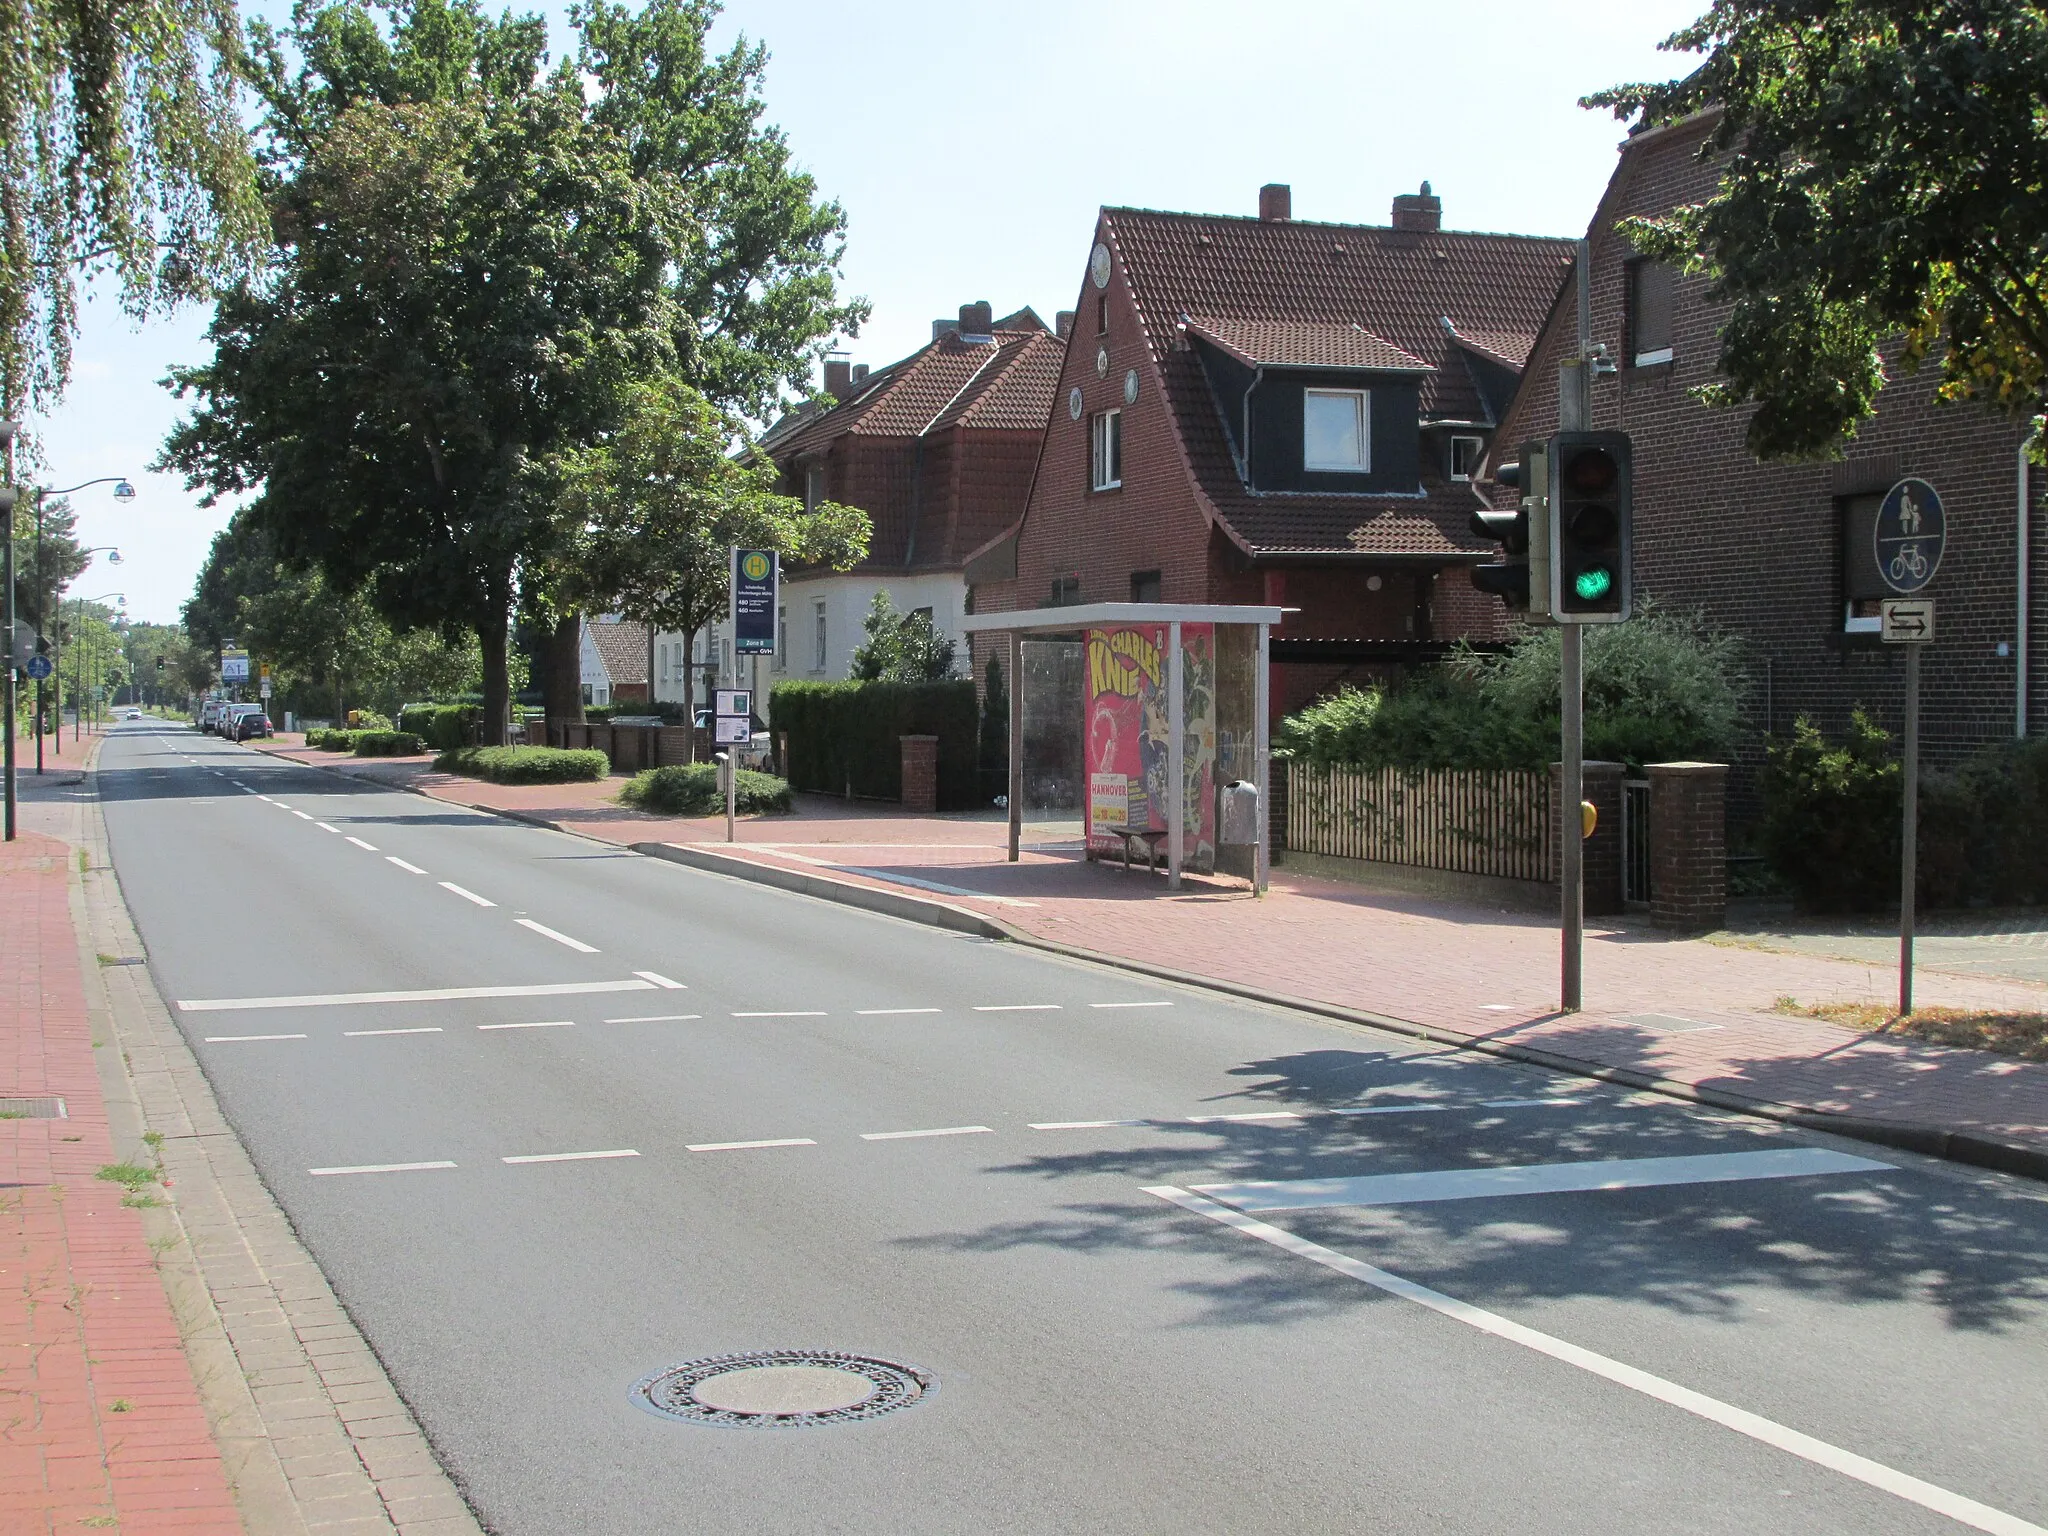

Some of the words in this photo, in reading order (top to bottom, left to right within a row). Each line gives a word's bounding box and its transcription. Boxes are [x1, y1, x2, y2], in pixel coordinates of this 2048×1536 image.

[1089, 641, 1141, 700] KNIE
[1111, 631, 1160, 688] CHARLES
[1092, 783, 1127, 797] HANNOVER
